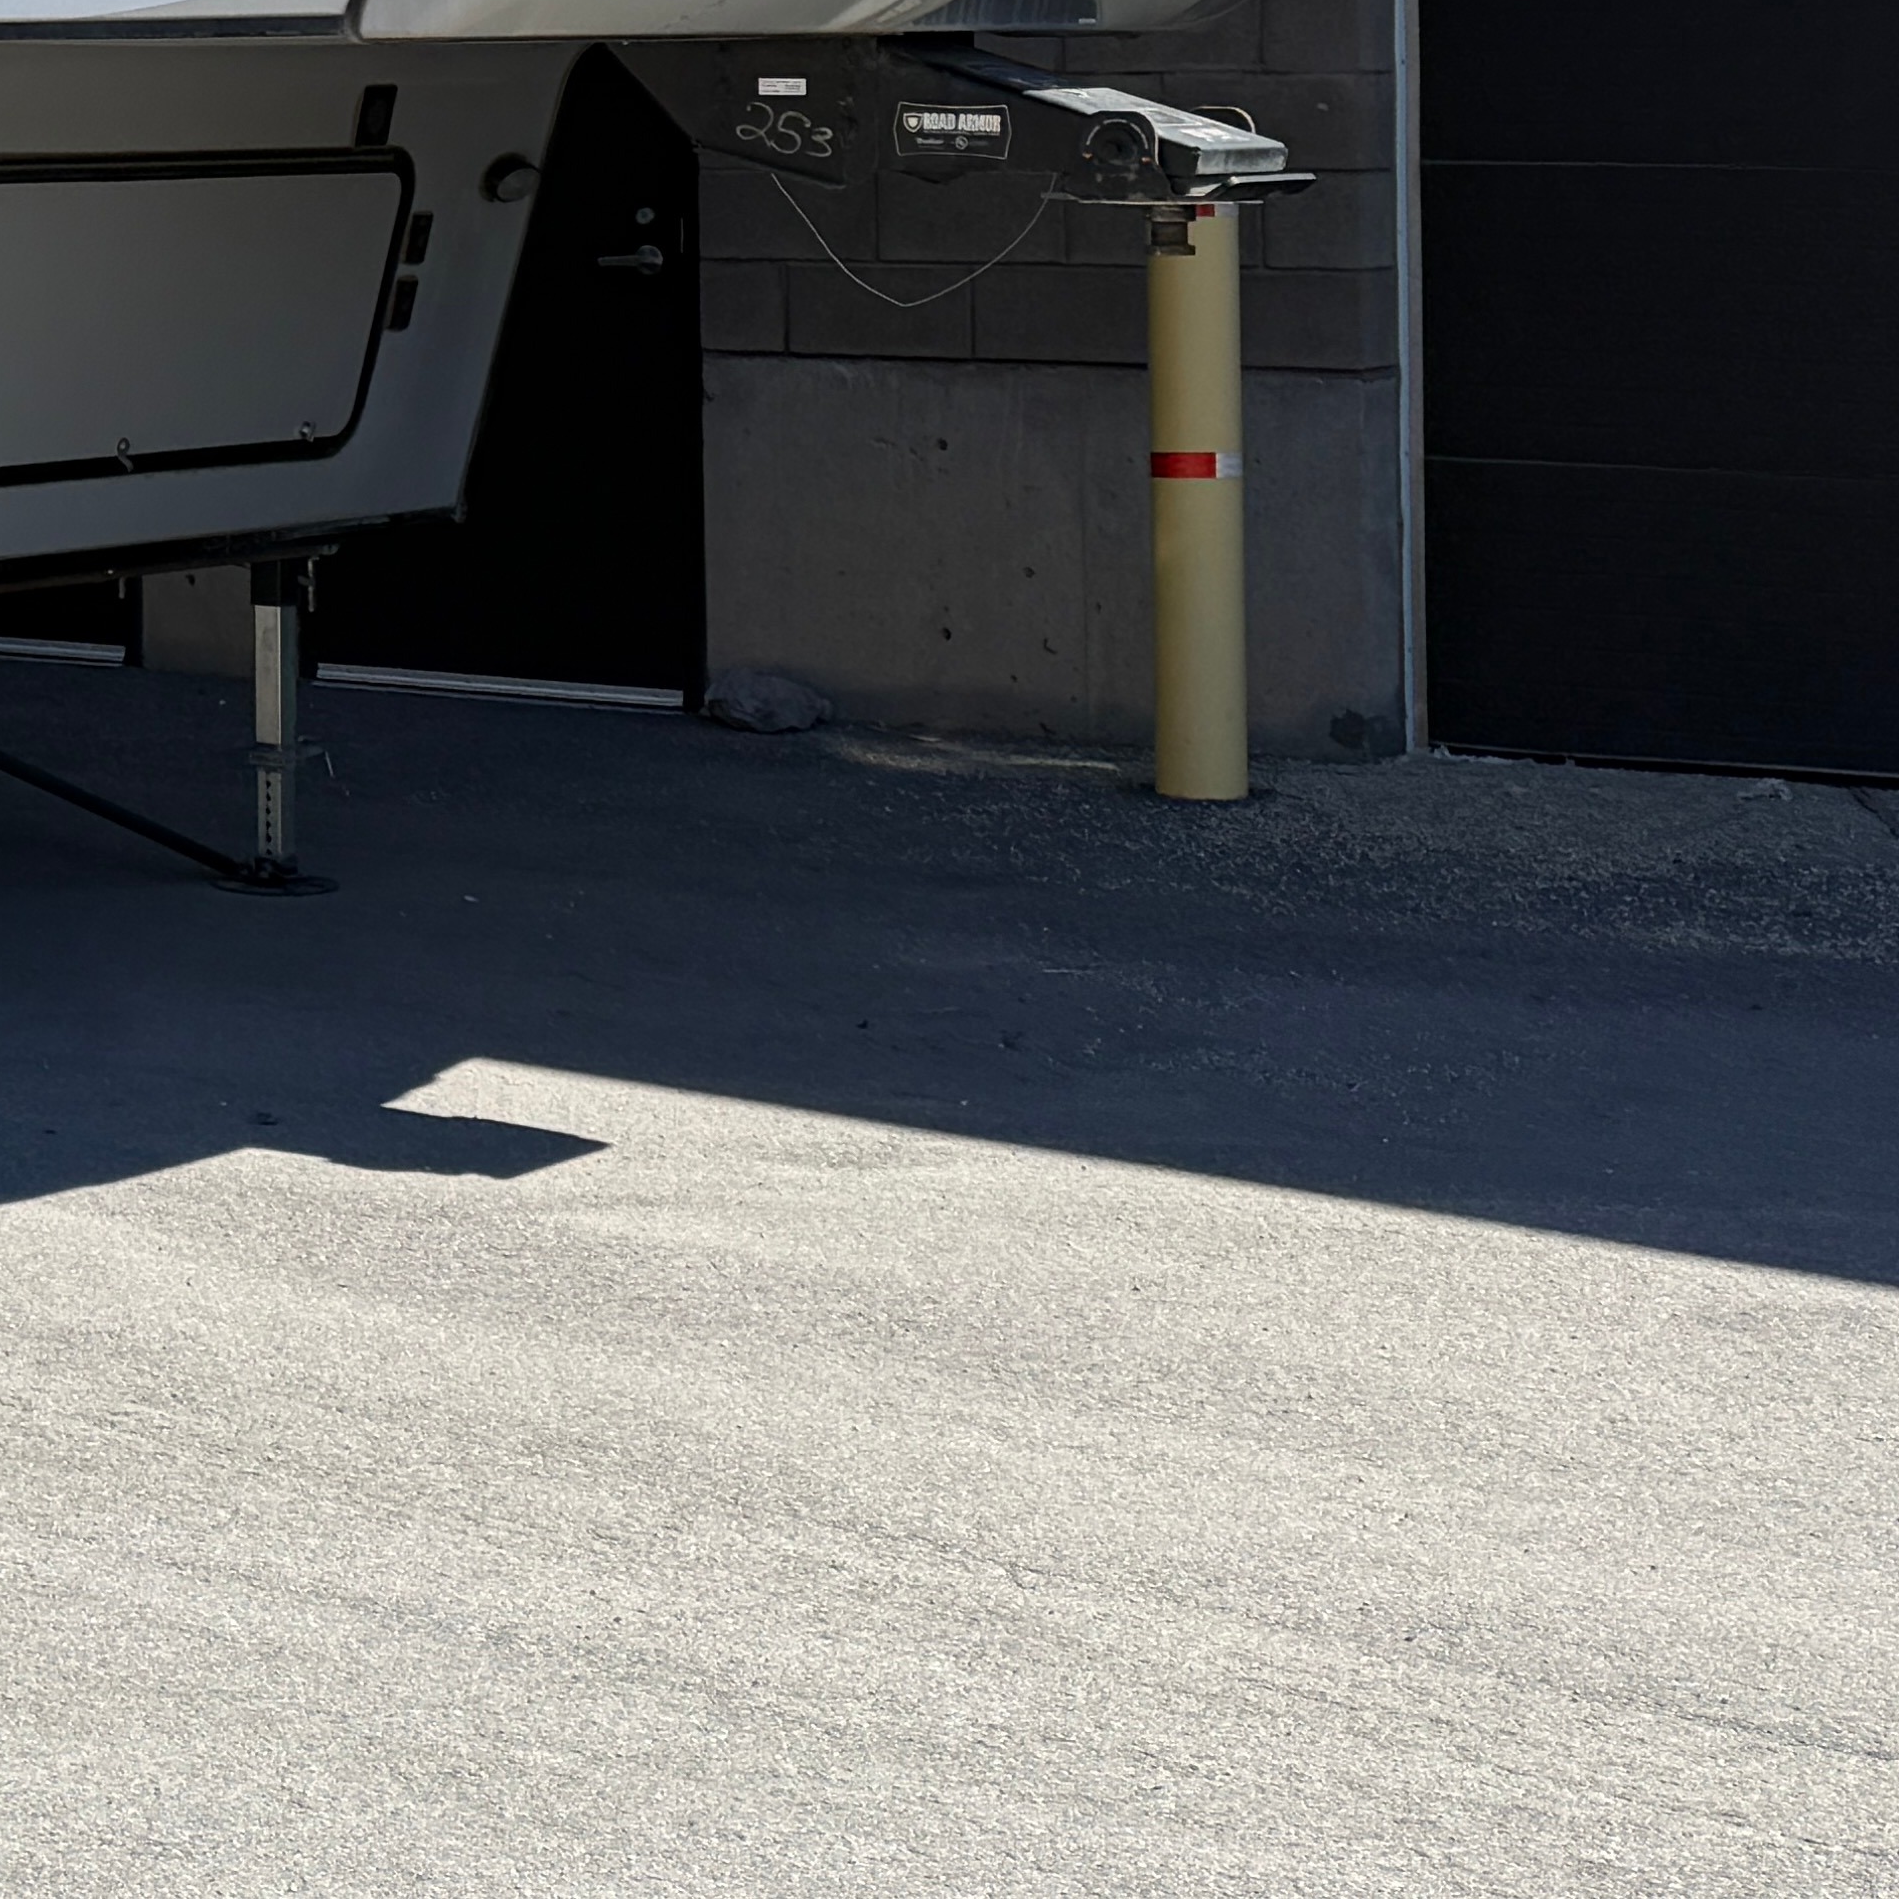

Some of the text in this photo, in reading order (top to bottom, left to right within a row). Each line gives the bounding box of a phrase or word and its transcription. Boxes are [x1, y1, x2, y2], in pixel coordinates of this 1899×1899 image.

[735, 101, 834, 158] 253
[923, 112, 1001, 133] ROAD ARMOR
